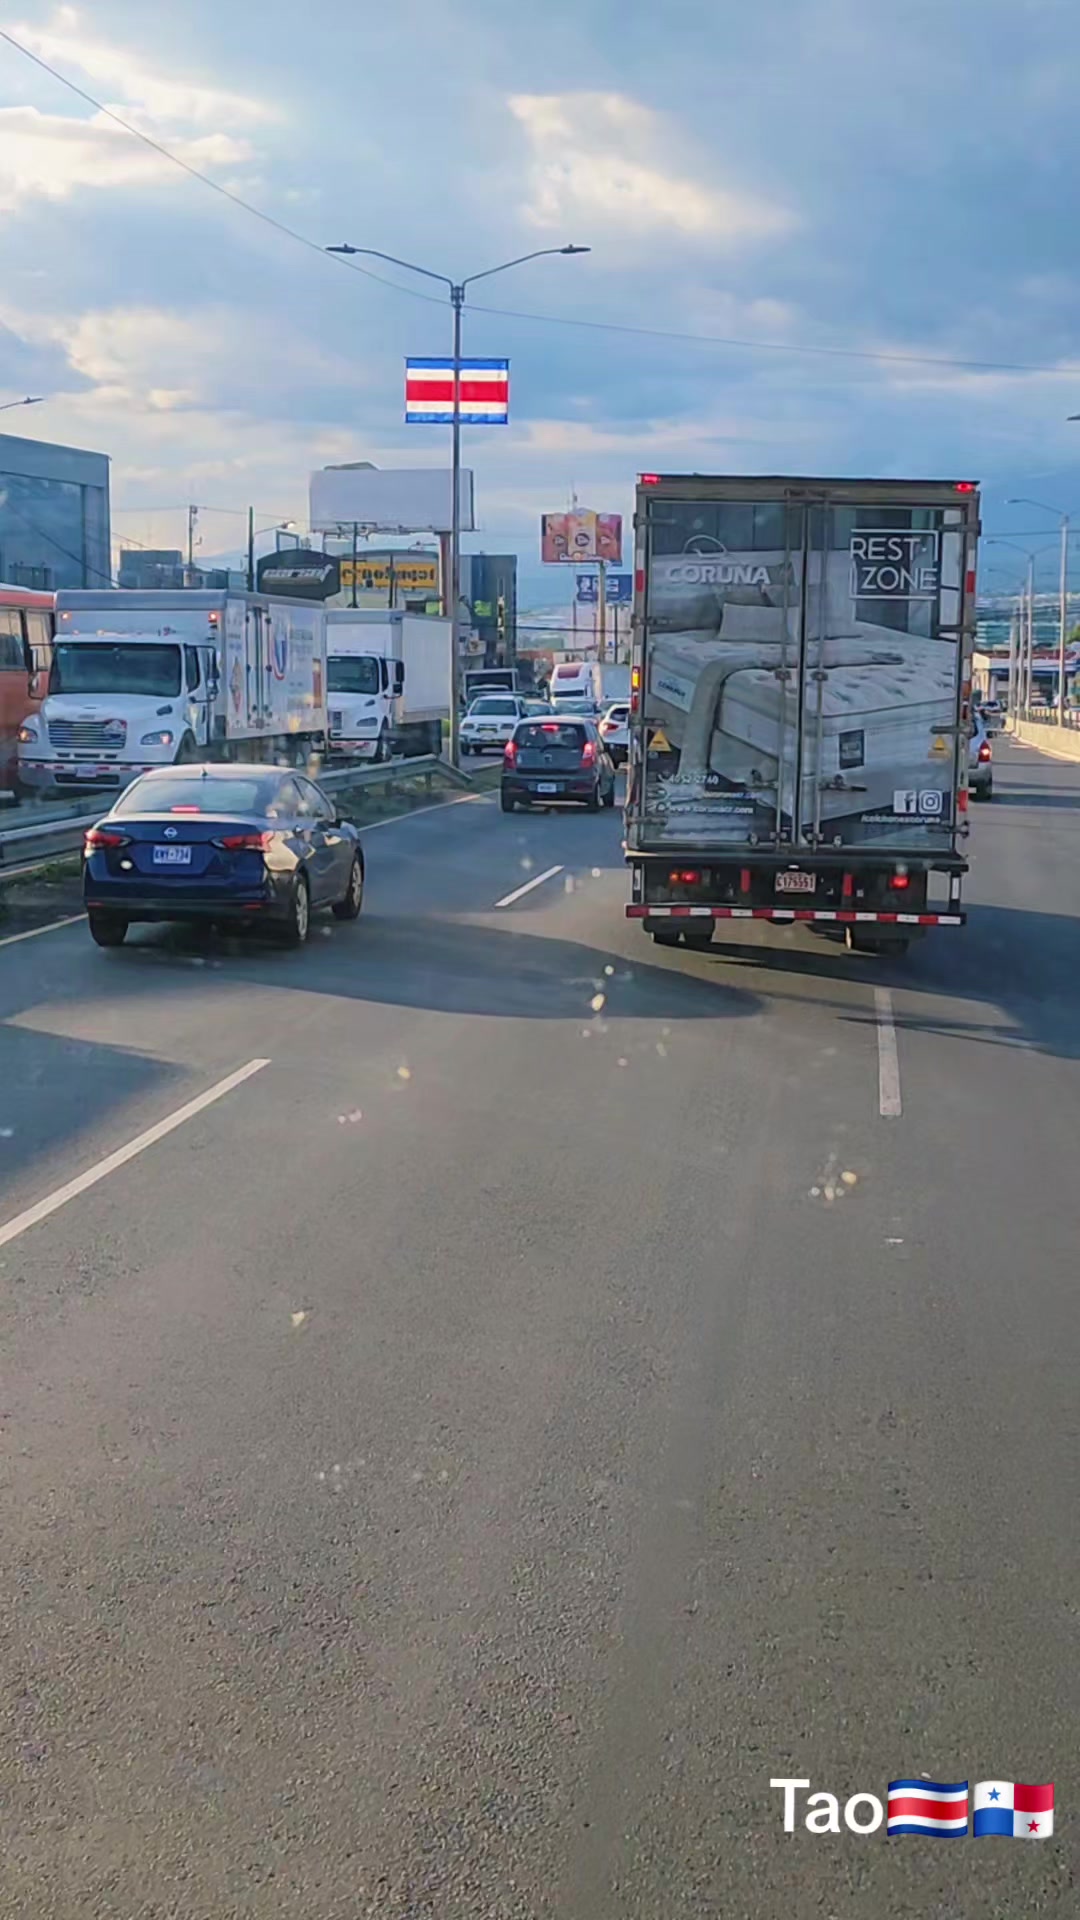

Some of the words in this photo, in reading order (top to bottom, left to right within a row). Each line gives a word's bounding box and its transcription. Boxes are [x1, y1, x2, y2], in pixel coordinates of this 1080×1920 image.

[850, 537, 921, 561] REST
[665, 565, 771, 585] CORUNA
[861, 567, 938, 590] ZONE
